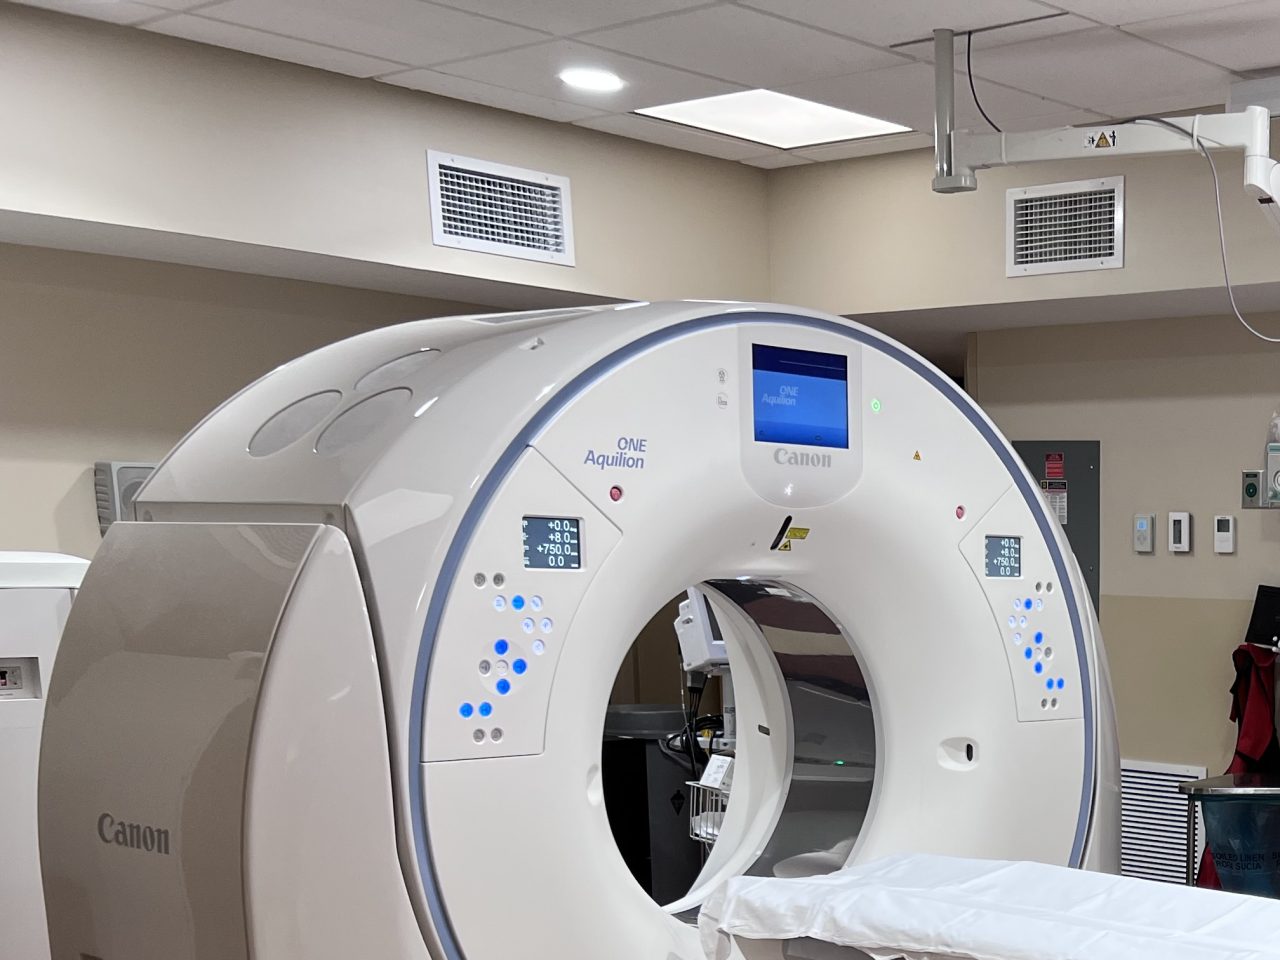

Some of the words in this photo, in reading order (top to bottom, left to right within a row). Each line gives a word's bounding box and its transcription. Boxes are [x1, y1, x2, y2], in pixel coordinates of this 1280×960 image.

[779, 385, 799, 397] ONE
[761, 393, 796, 407] Aquilion
[617, 437, 647, 453] ONE
[584, 450, 644, 470] Aquilion
[773, 448, 832, 468] Canon
[548, 520, 570, 531] +0.0
[548, 532, 571, 543] +8.0
[537, 543, 571, 555] +750.0
[548, 556, 565, 567] 0.0
[98, 812, 170, 855] Canon
[1235, 862, 1262, 871] SUCIA
